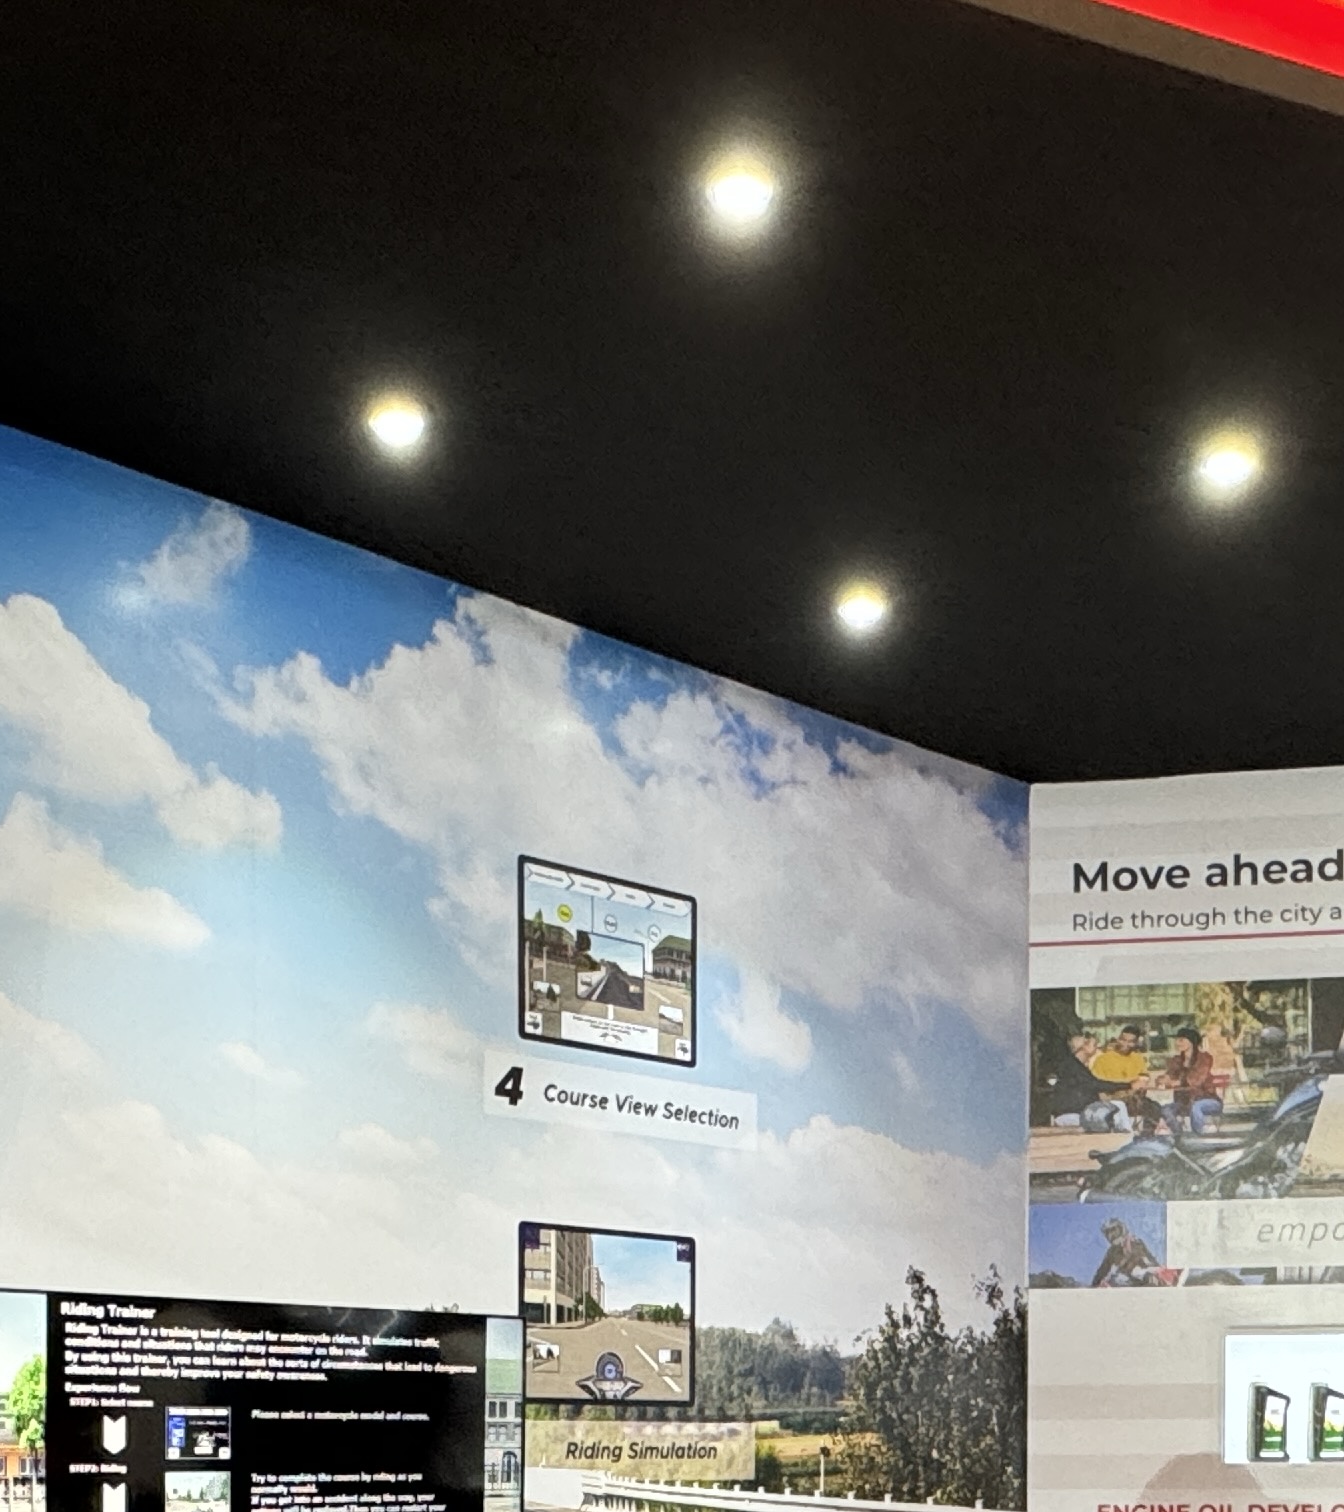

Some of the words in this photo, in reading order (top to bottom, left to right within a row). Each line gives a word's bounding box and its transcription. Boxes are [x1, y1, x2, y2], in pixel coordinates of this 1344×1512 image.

[1071, 861, 1191, 894] Move
[1205, 848, 1344, 888] ahead
[1072, 912, 1124, 932] Ride
[1130, 906, 1226, 932] through
[1234, 904, 1273, 925] the
[1279, 903, 1324, 927] city
[494, 1066, 524, 1106] 4
[543, 1083, 609, 1112] Course
[616, 1093, 658, 1118] View
[662, 1101, 740, 1131] Selection
[61, 1302, 104, 1319] Riding
[107, 1304, 156, 1320] Trainer
[565, 1440, 623, 1464] Riding
[627, 1440, 718, 1462] Simulation
